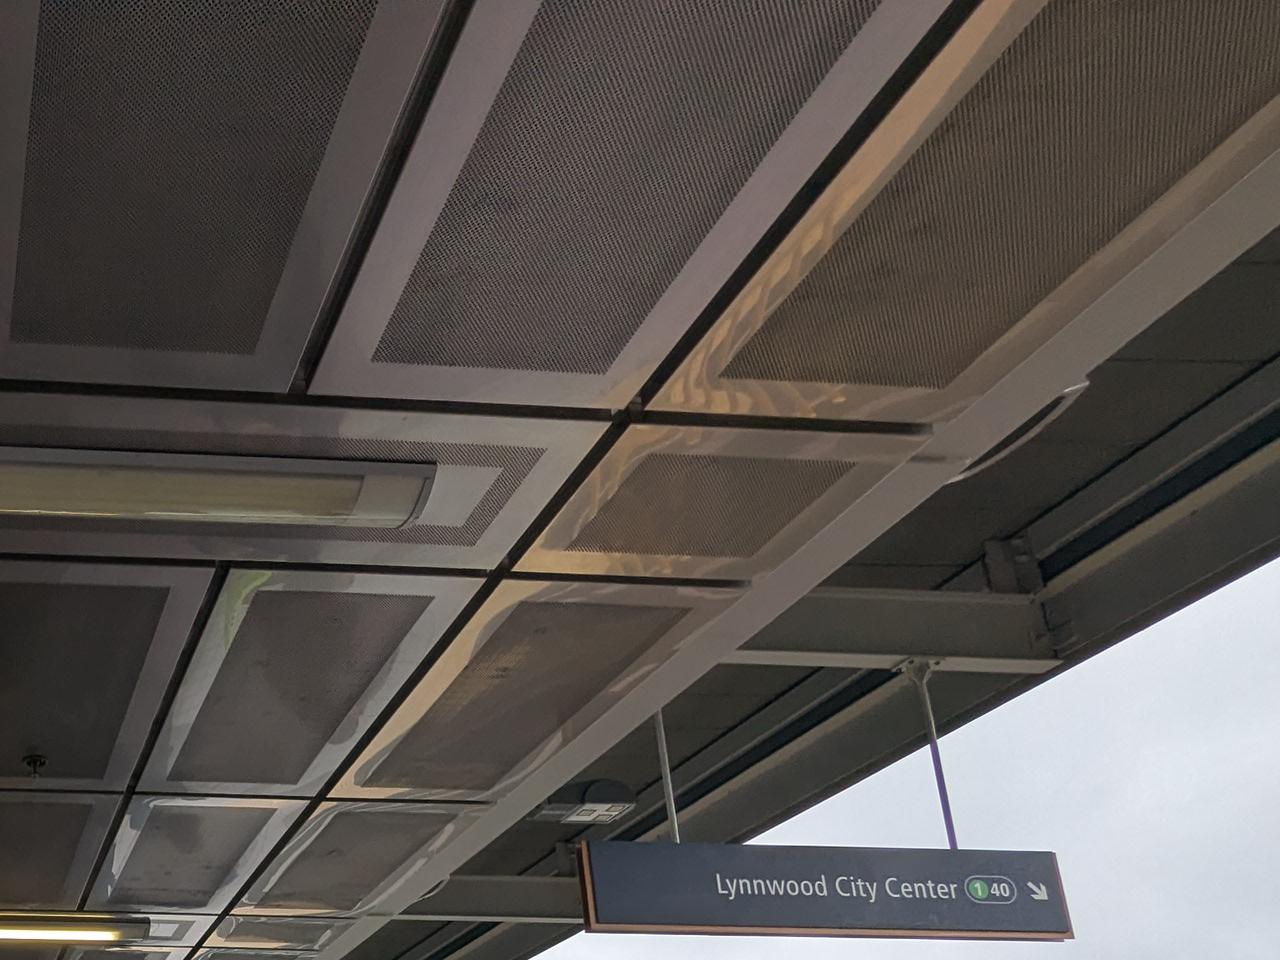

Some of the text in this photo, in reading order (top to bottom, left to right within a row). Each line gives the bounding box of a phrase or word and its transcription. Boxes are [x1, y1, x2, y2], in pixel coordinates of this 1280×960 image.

[716, 873, 828, 900] Lynnwood
[835, 876, 877, 903] City
[885, 877, 958, 899] Center
[990, 882, 1010, 897] 40
